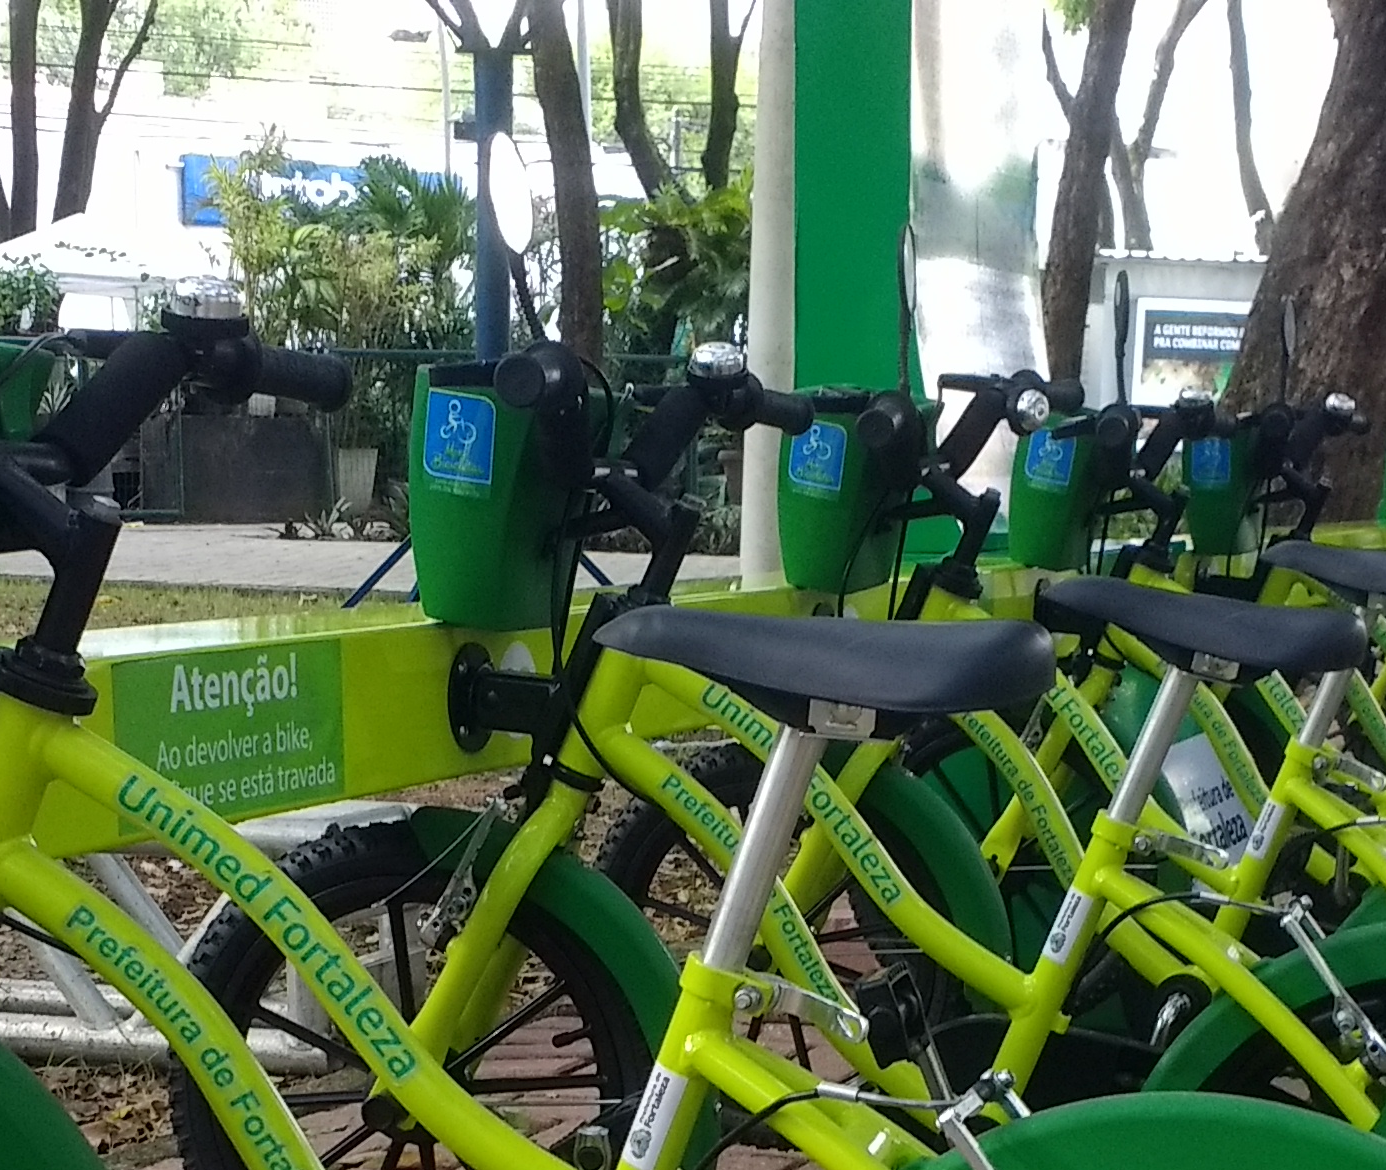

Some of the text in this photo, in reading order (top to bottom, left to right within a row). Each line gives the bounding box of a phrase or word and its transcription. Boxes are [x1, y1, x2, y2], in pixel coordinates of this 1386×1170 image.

[170, 652, 298, 717] Atenção!
[701, 683, 776, 754] Unim
[157, 720, 313, 771] Ao devolver a bike,
[219, 779, 236, 803] se
[241, 765, 273, 798] está
[278, 756, 336, 790] travada
[662, 773, 740, 852] Prefeitu
[1017, 779, 1034, 803] de
[1031, 804, 1074, 884] Fortalez
[118, 774, 417, 1079] Unimed Fortaleza
[66, 904, 204, 1045] Prefeitura
[202, 1047, 237, 1088] de
[644, 1077, 670, 1128] Fortaleza
